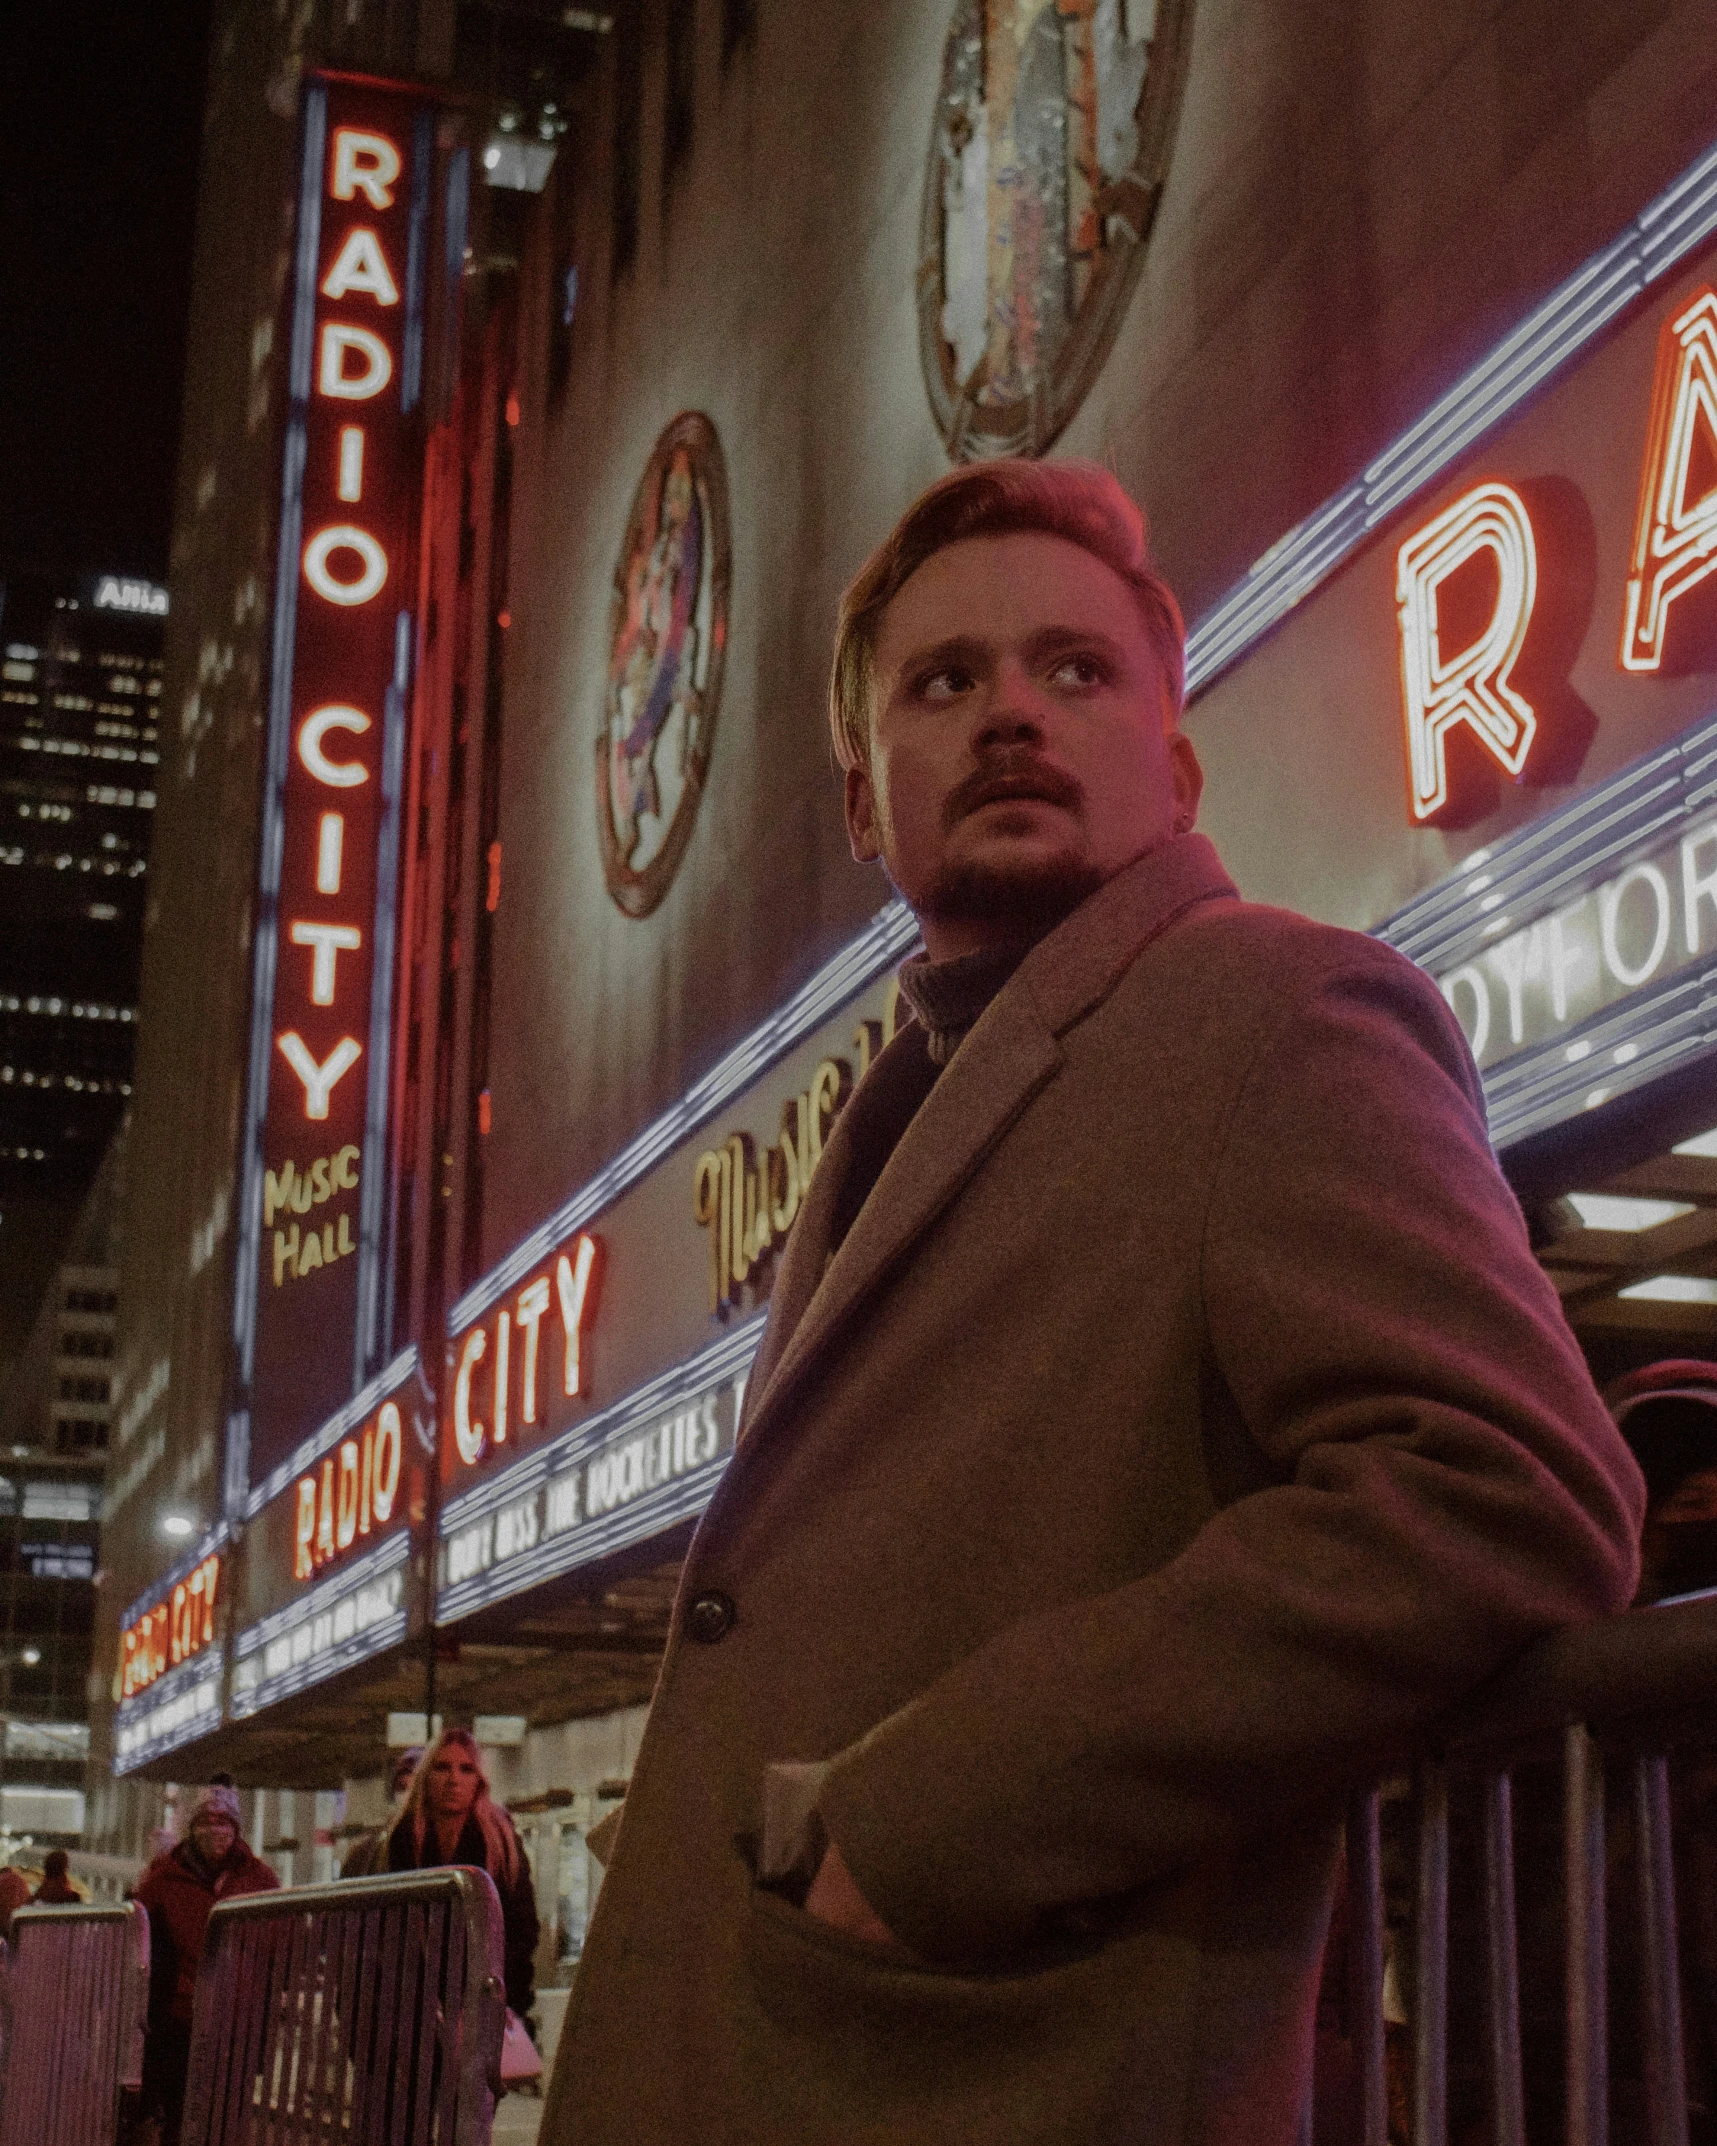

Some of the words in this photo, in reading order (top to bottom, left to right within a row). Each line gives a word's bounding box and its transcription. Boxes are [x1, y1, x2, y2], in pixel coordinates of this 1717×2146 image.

[303, 127, 402, 607] RADIO
[277, 704, 373, 1121] CITY
[273, 1213, 357, 1288] HALL
[454, 1233, 596, 1466] CITY
[294, 1401, 402, 1580] RADIO
